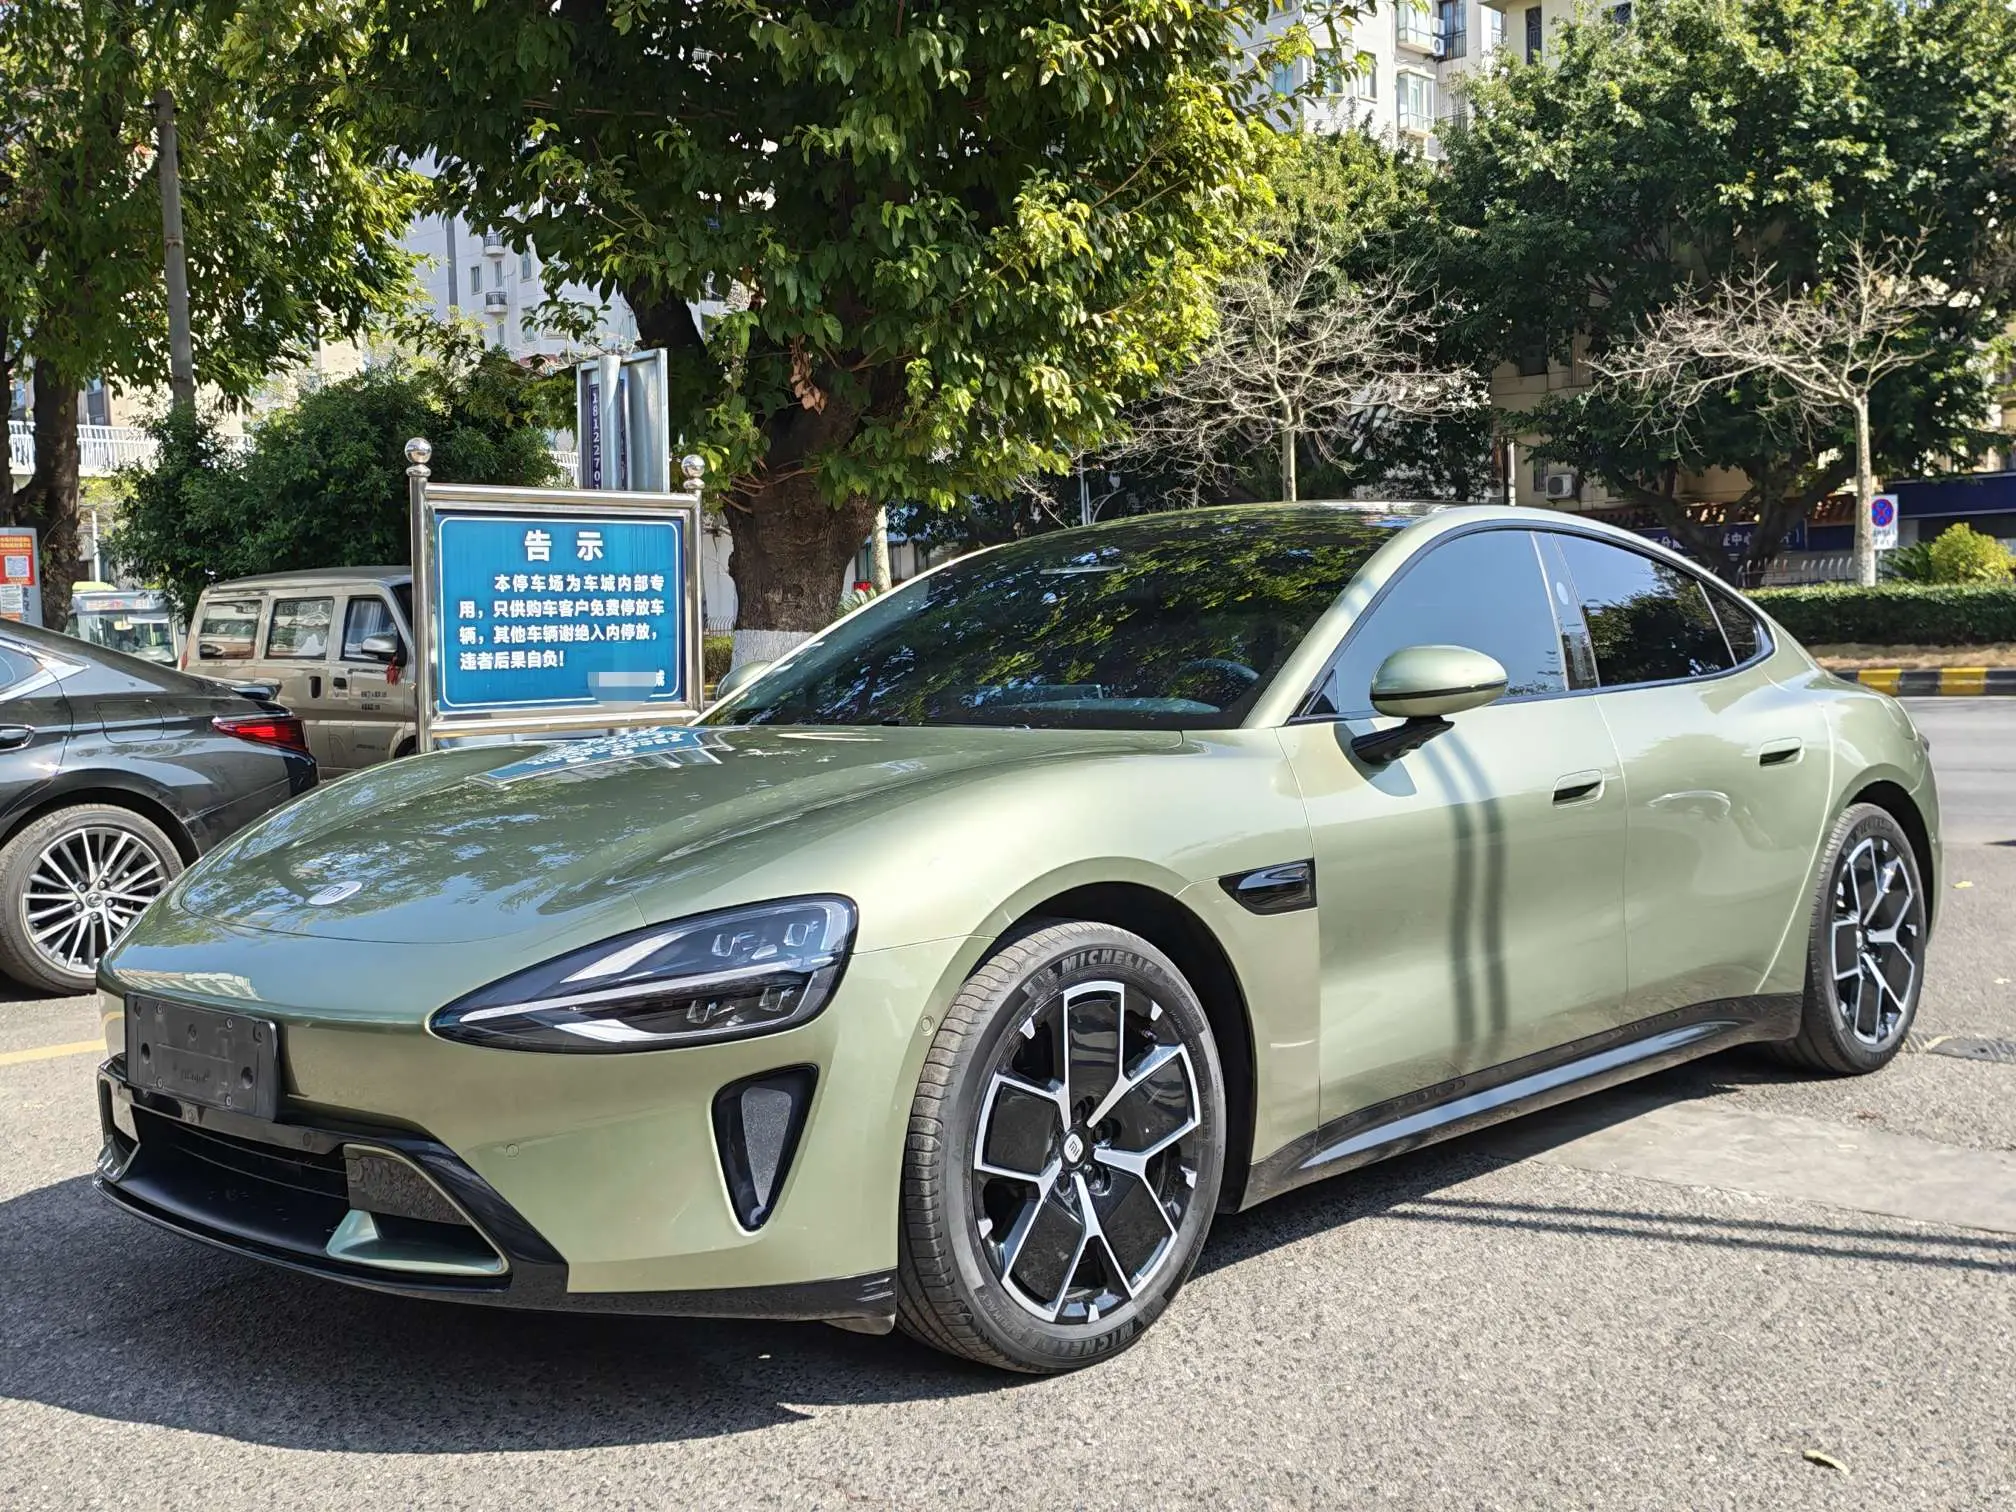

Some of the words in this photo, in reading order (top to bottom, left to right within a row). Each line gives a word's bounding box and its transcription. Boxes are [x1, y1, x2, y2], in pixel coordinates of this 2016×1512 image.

[493, 573, 665, 593] 本停车场为车城内部专
[458, 598, 665, 619] 用，只供购车客户免费停放车
[1061, 948, 1158, 976] MICHELIN
